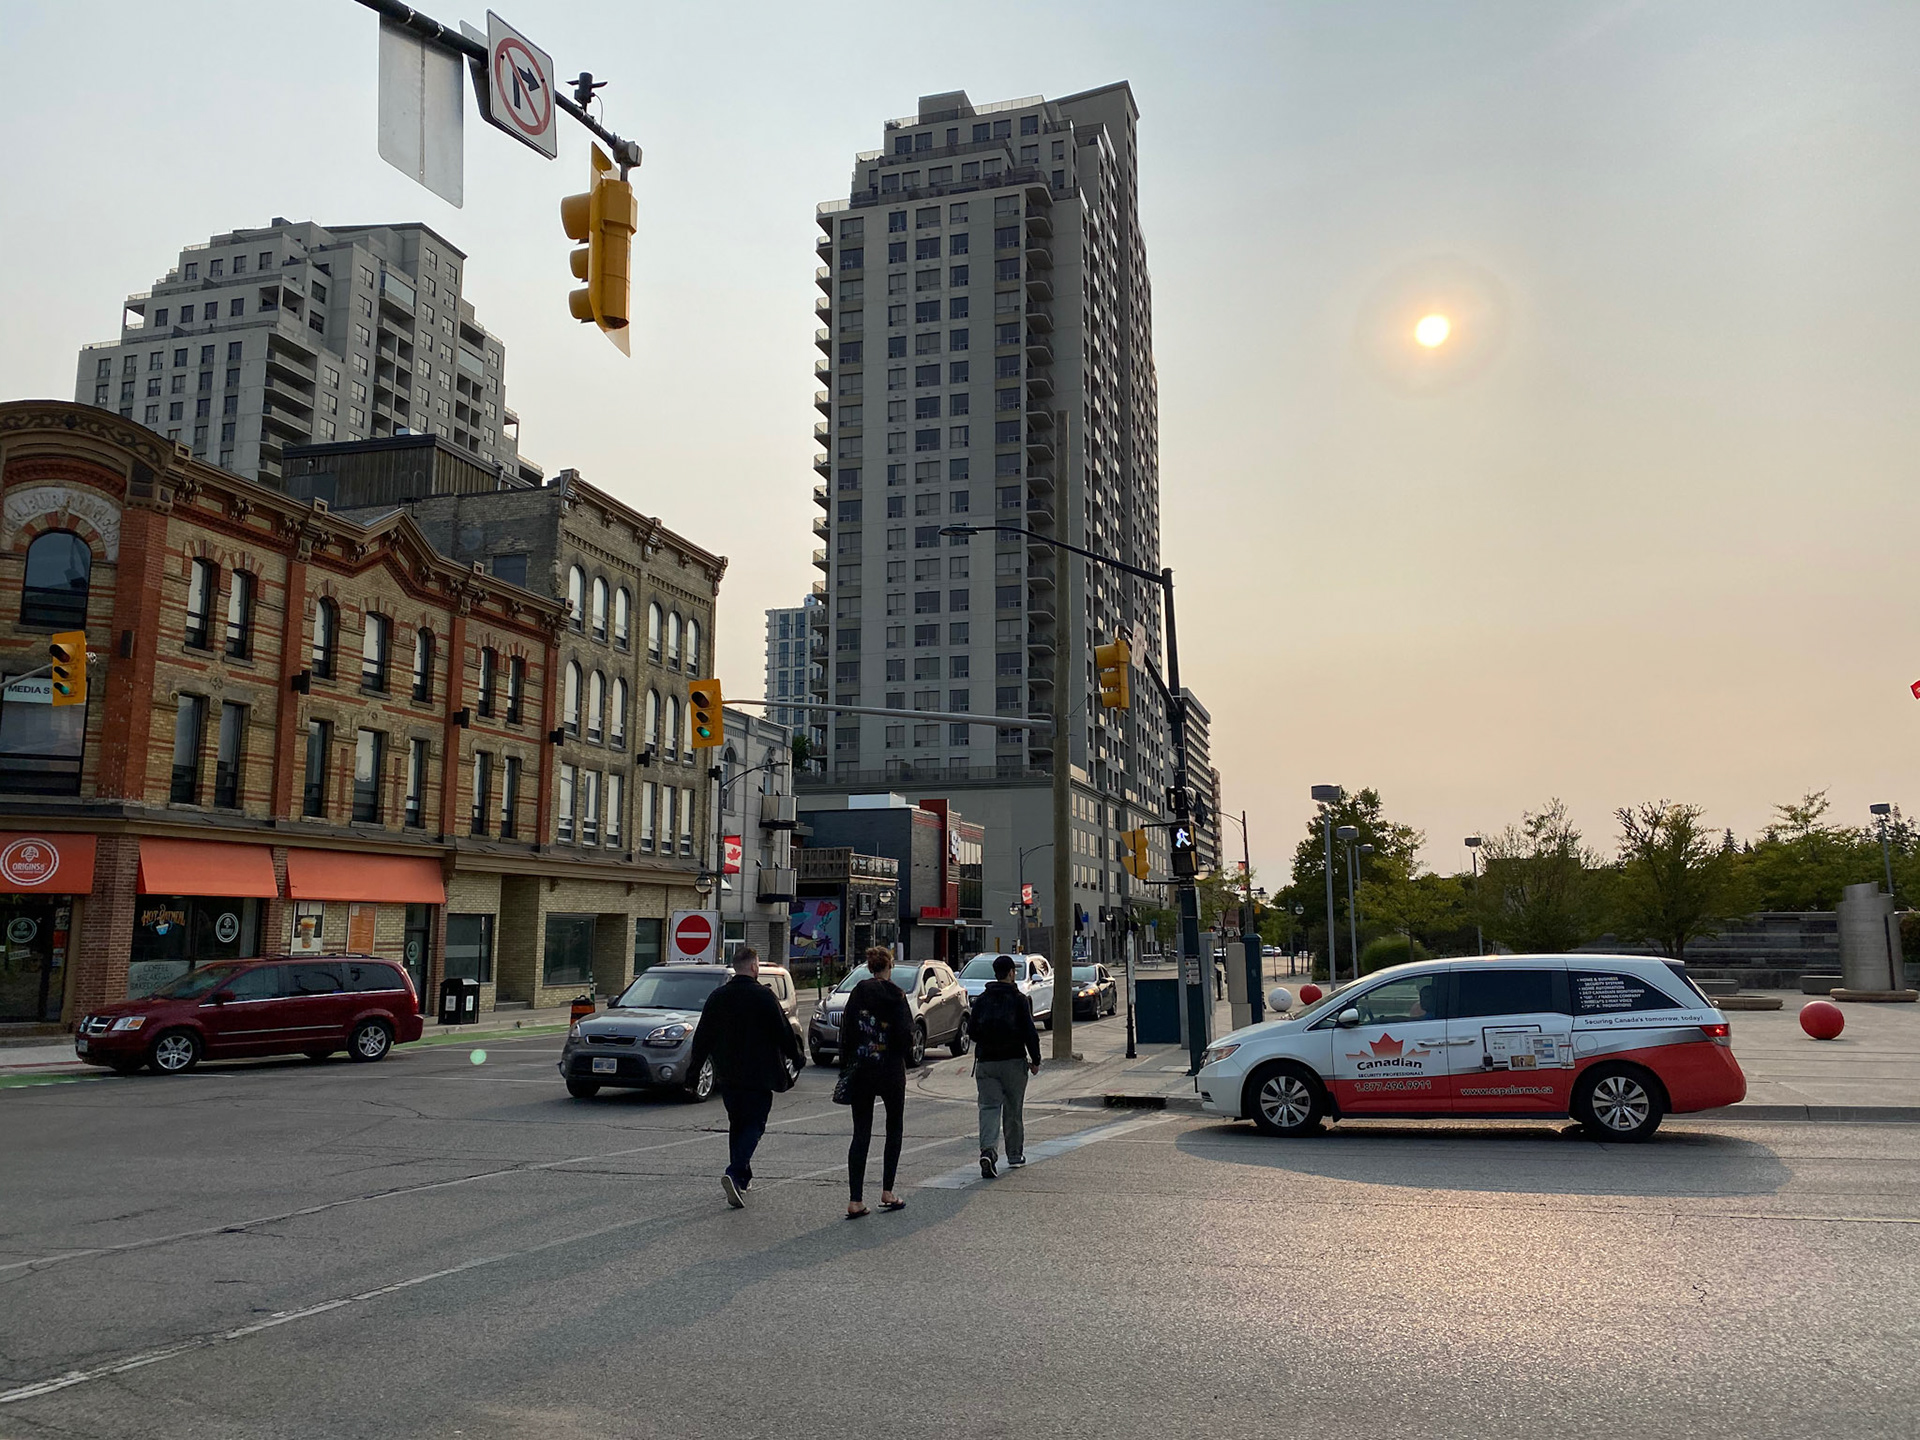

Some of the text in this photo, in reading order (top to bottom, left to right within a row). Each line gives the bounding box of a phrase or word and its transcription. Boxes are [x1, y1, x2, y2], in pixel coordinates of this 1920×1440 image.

[8, 685, 42, 694] MEDIA
[12, 862, 41, 871] ORIGINS
[1357, 1057, 1422, 1071] Canadian
[1354, 1080, 1432, 1092] 1.877.494.9911
[1460, 1085, 1554, 1096] www.cspalarms.ca
